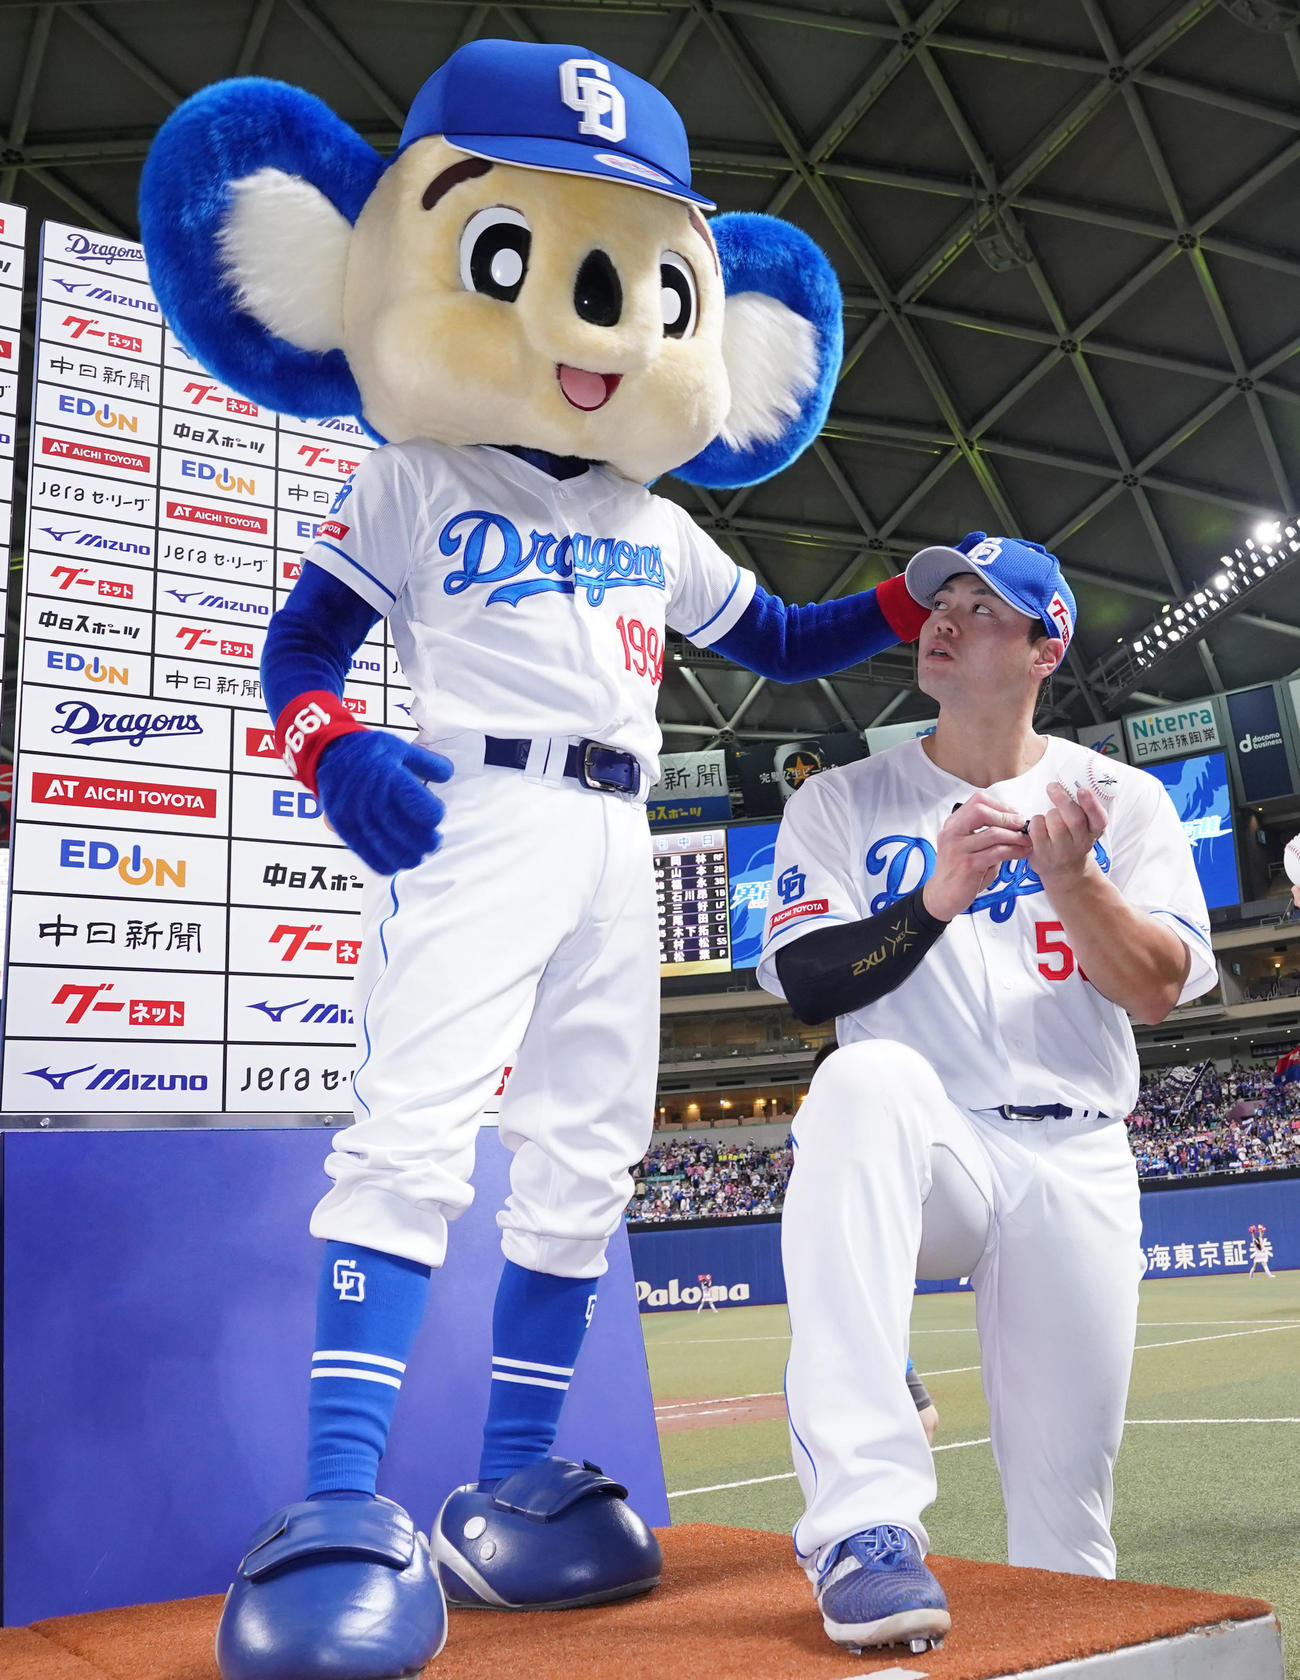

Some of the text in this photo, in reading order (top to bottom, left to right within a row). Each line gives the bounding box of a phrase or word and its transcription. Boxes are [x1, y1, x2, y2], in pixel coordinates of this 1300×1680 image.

[65, 233, 145, 264] Dragons
[50, 356, 150, 393] 中日新聞
[58, 394, 138, 433] EDION
[173, 422, 265, 454] 中日スポーツ
[49, 440, 144, 469] AT AICHI TOYOTA
[181, 459, 256, 496] EDION
[288, 484, 341, 505] 中日
[172, 504, 262, 530] AT AICHI TOYOTA
[438, 510, 665, 607] Dragons
[38, 610, 141, 640] 中日スポーツ
[47, 649, 129, 686] EDION
[165, 670, 262, 700] 中日新聞
[51, 700, 204, 747] Dragons
[1131, 708, 1213, 741] Niterra
[1252, 732, 1280, 743] docomo
[1136, 726, 1217, 757] 日本特殊陶業
[1253, 738, 1283, 749] business
[664, 763, 722, 791] 新聞
[45, 778, 205, 810] AT AICHI TOYOTA
[646, 805, 703, 821] 日スポーツ
[60, 838, 187, 888] EDION
[263, 862, 364, 892] 中日スポー
[793, 902, 824, 915] TOYOTA
[39, 913, 202, 953] 中日新聞
[1035, 920, 1090, 982] 5
[1147, 1239, 1274, 1271] 海東京証券
[635, 1278, 750, 1307] Paloma
